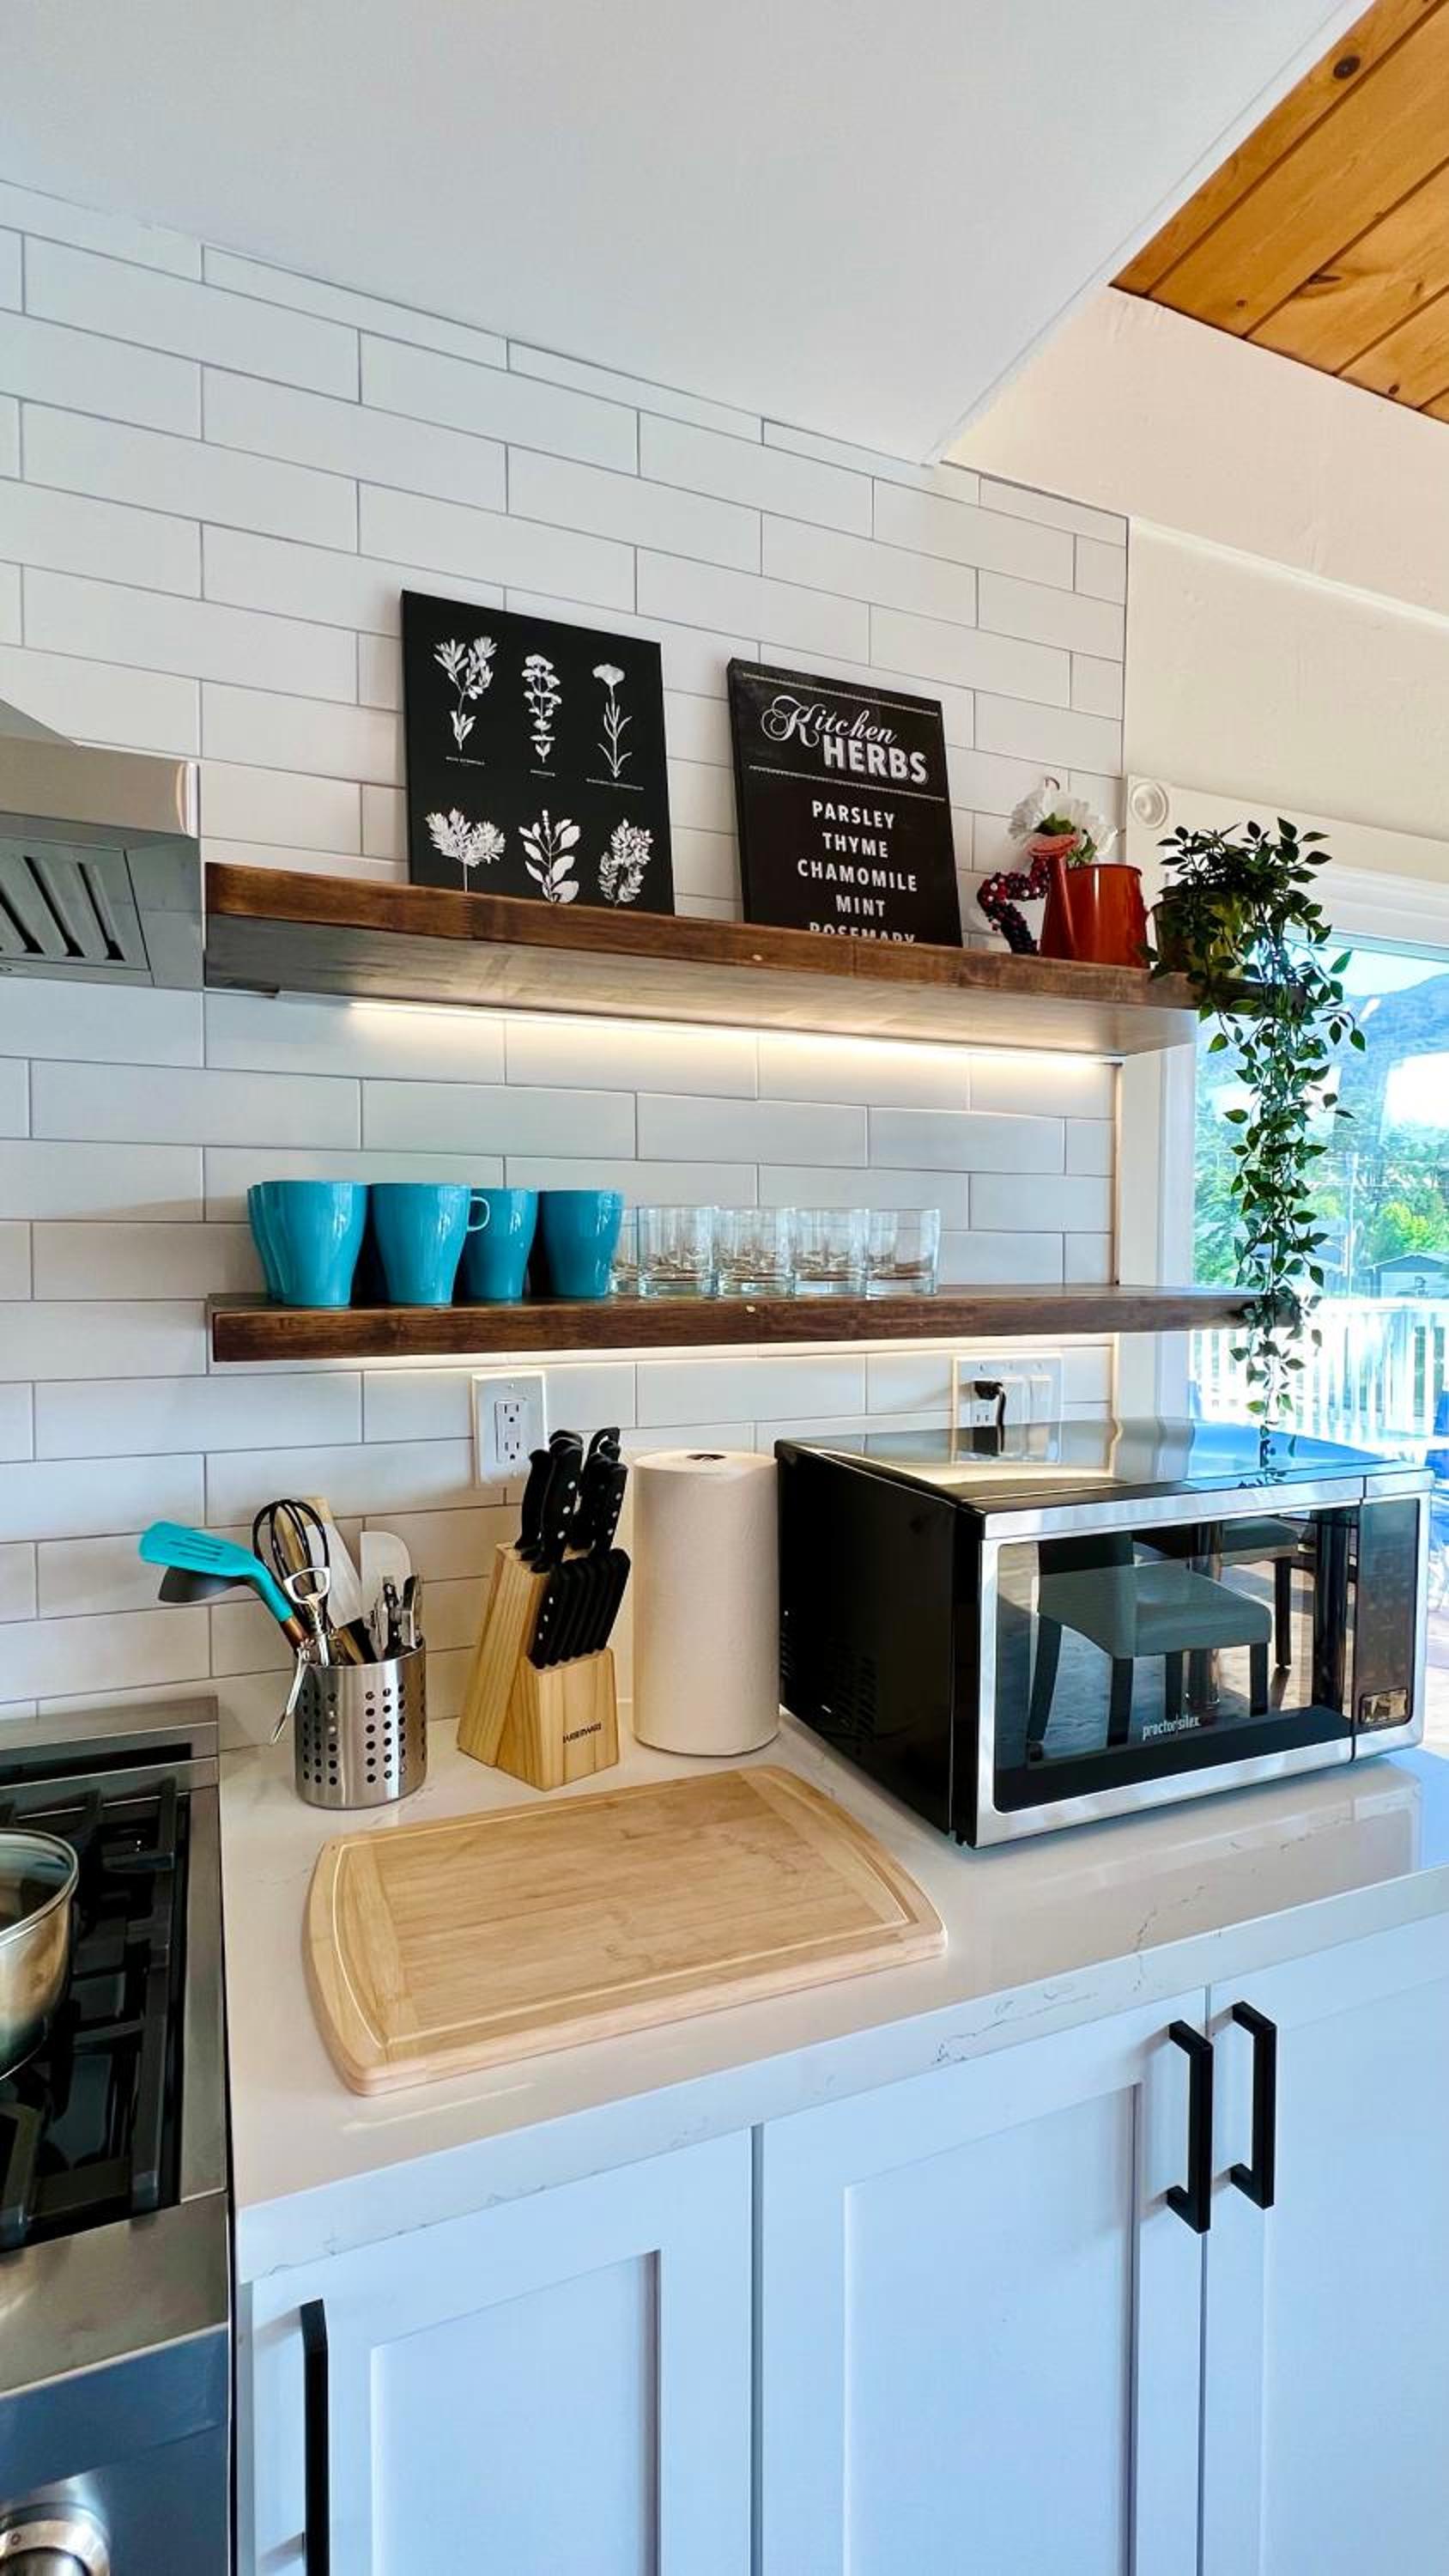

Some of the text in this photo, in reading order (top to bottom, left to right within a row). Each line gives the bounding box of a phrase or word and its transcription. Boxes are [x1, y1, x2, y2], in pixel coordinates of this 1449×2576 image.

[761, 695, 897, 747] Kitchen
[822, 734, 928, 784] HERBS
[811, 799, 894, 829] PARSLEY
[822, 832, 888, 858] THYME
[797, 859, 918, 892] CHAMOMILE
[835, 894, 886, 917] MINT
